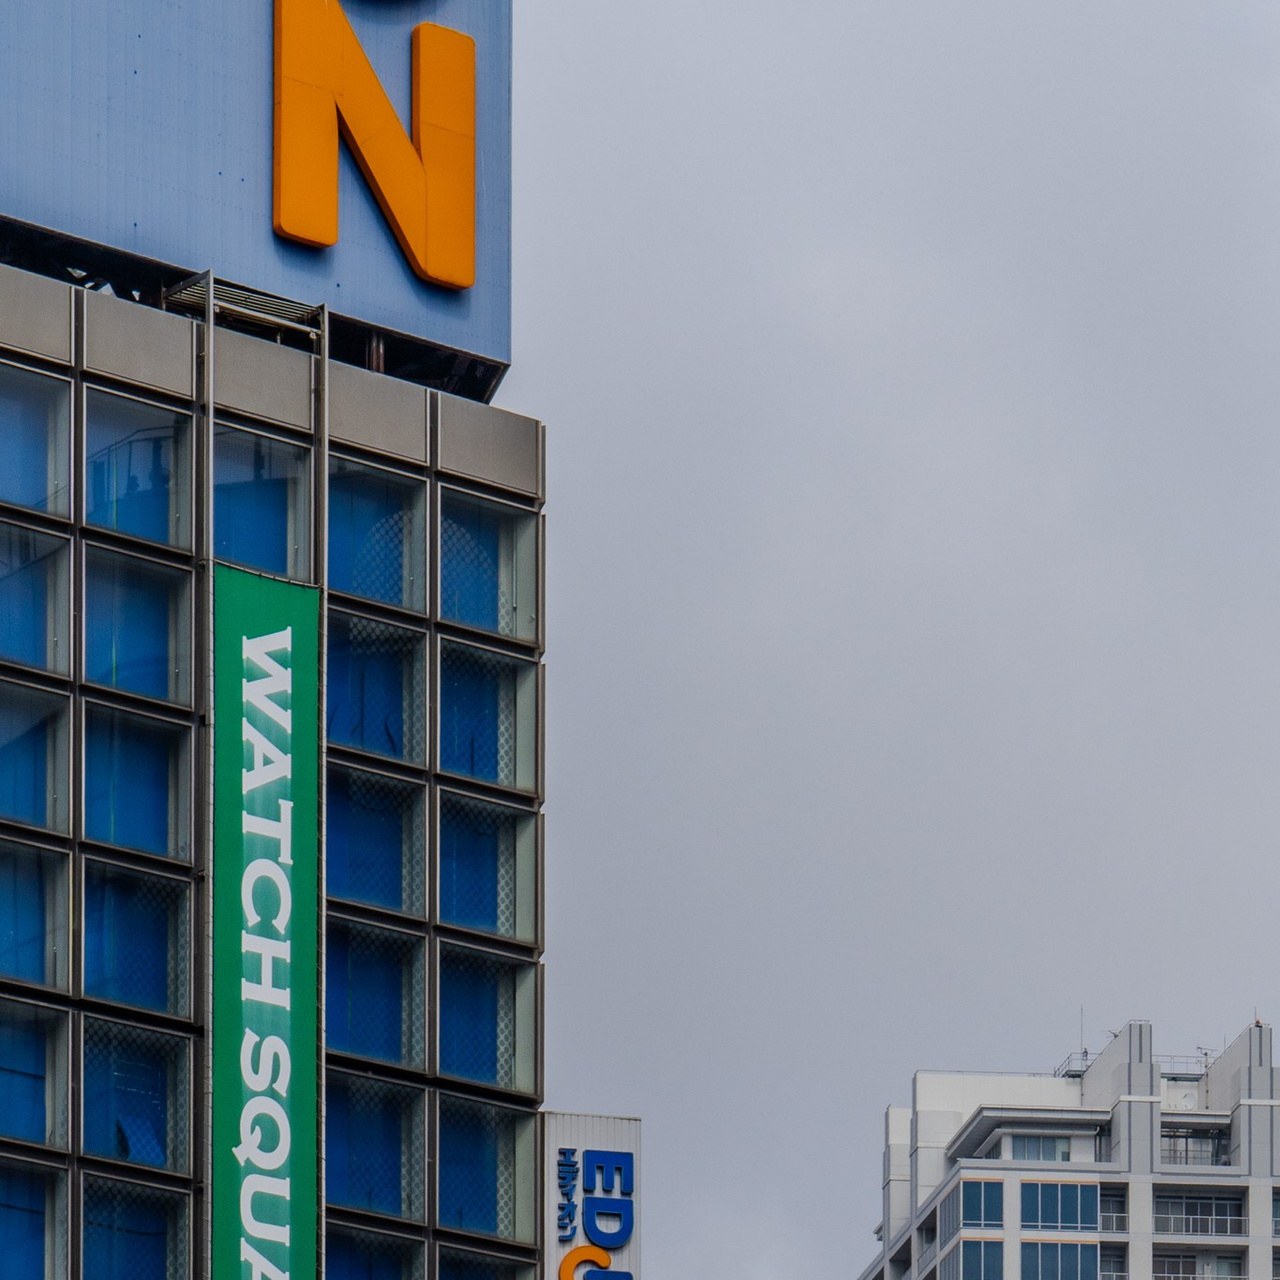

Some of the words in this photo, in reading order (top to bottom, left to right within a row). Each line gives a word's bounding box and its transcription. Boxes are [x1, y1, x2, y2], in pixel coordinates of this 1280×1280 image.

[273, 0, 477, 290] N
[240, 625, 294, 1012] WATCH
[557, 1148, 579, 1242] エディオン
